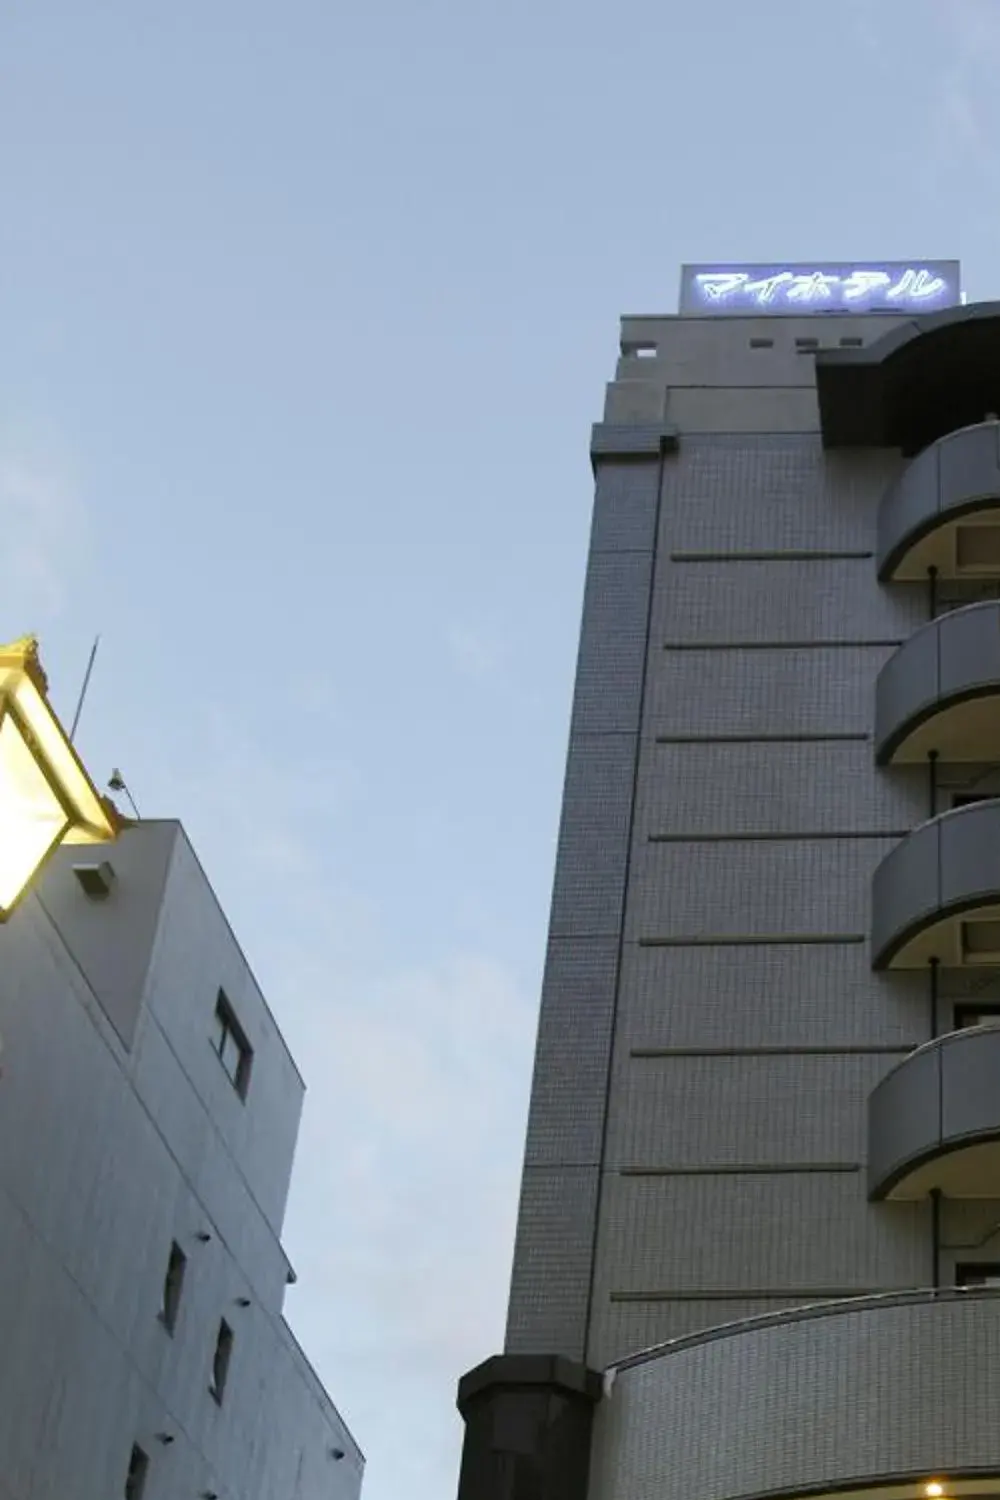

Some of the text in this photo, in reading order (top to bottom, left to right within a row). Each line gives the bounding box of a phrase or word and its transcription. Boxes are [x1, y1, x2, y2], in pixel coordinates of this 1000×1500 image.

[695, 269, 945, 302] マイホテル
